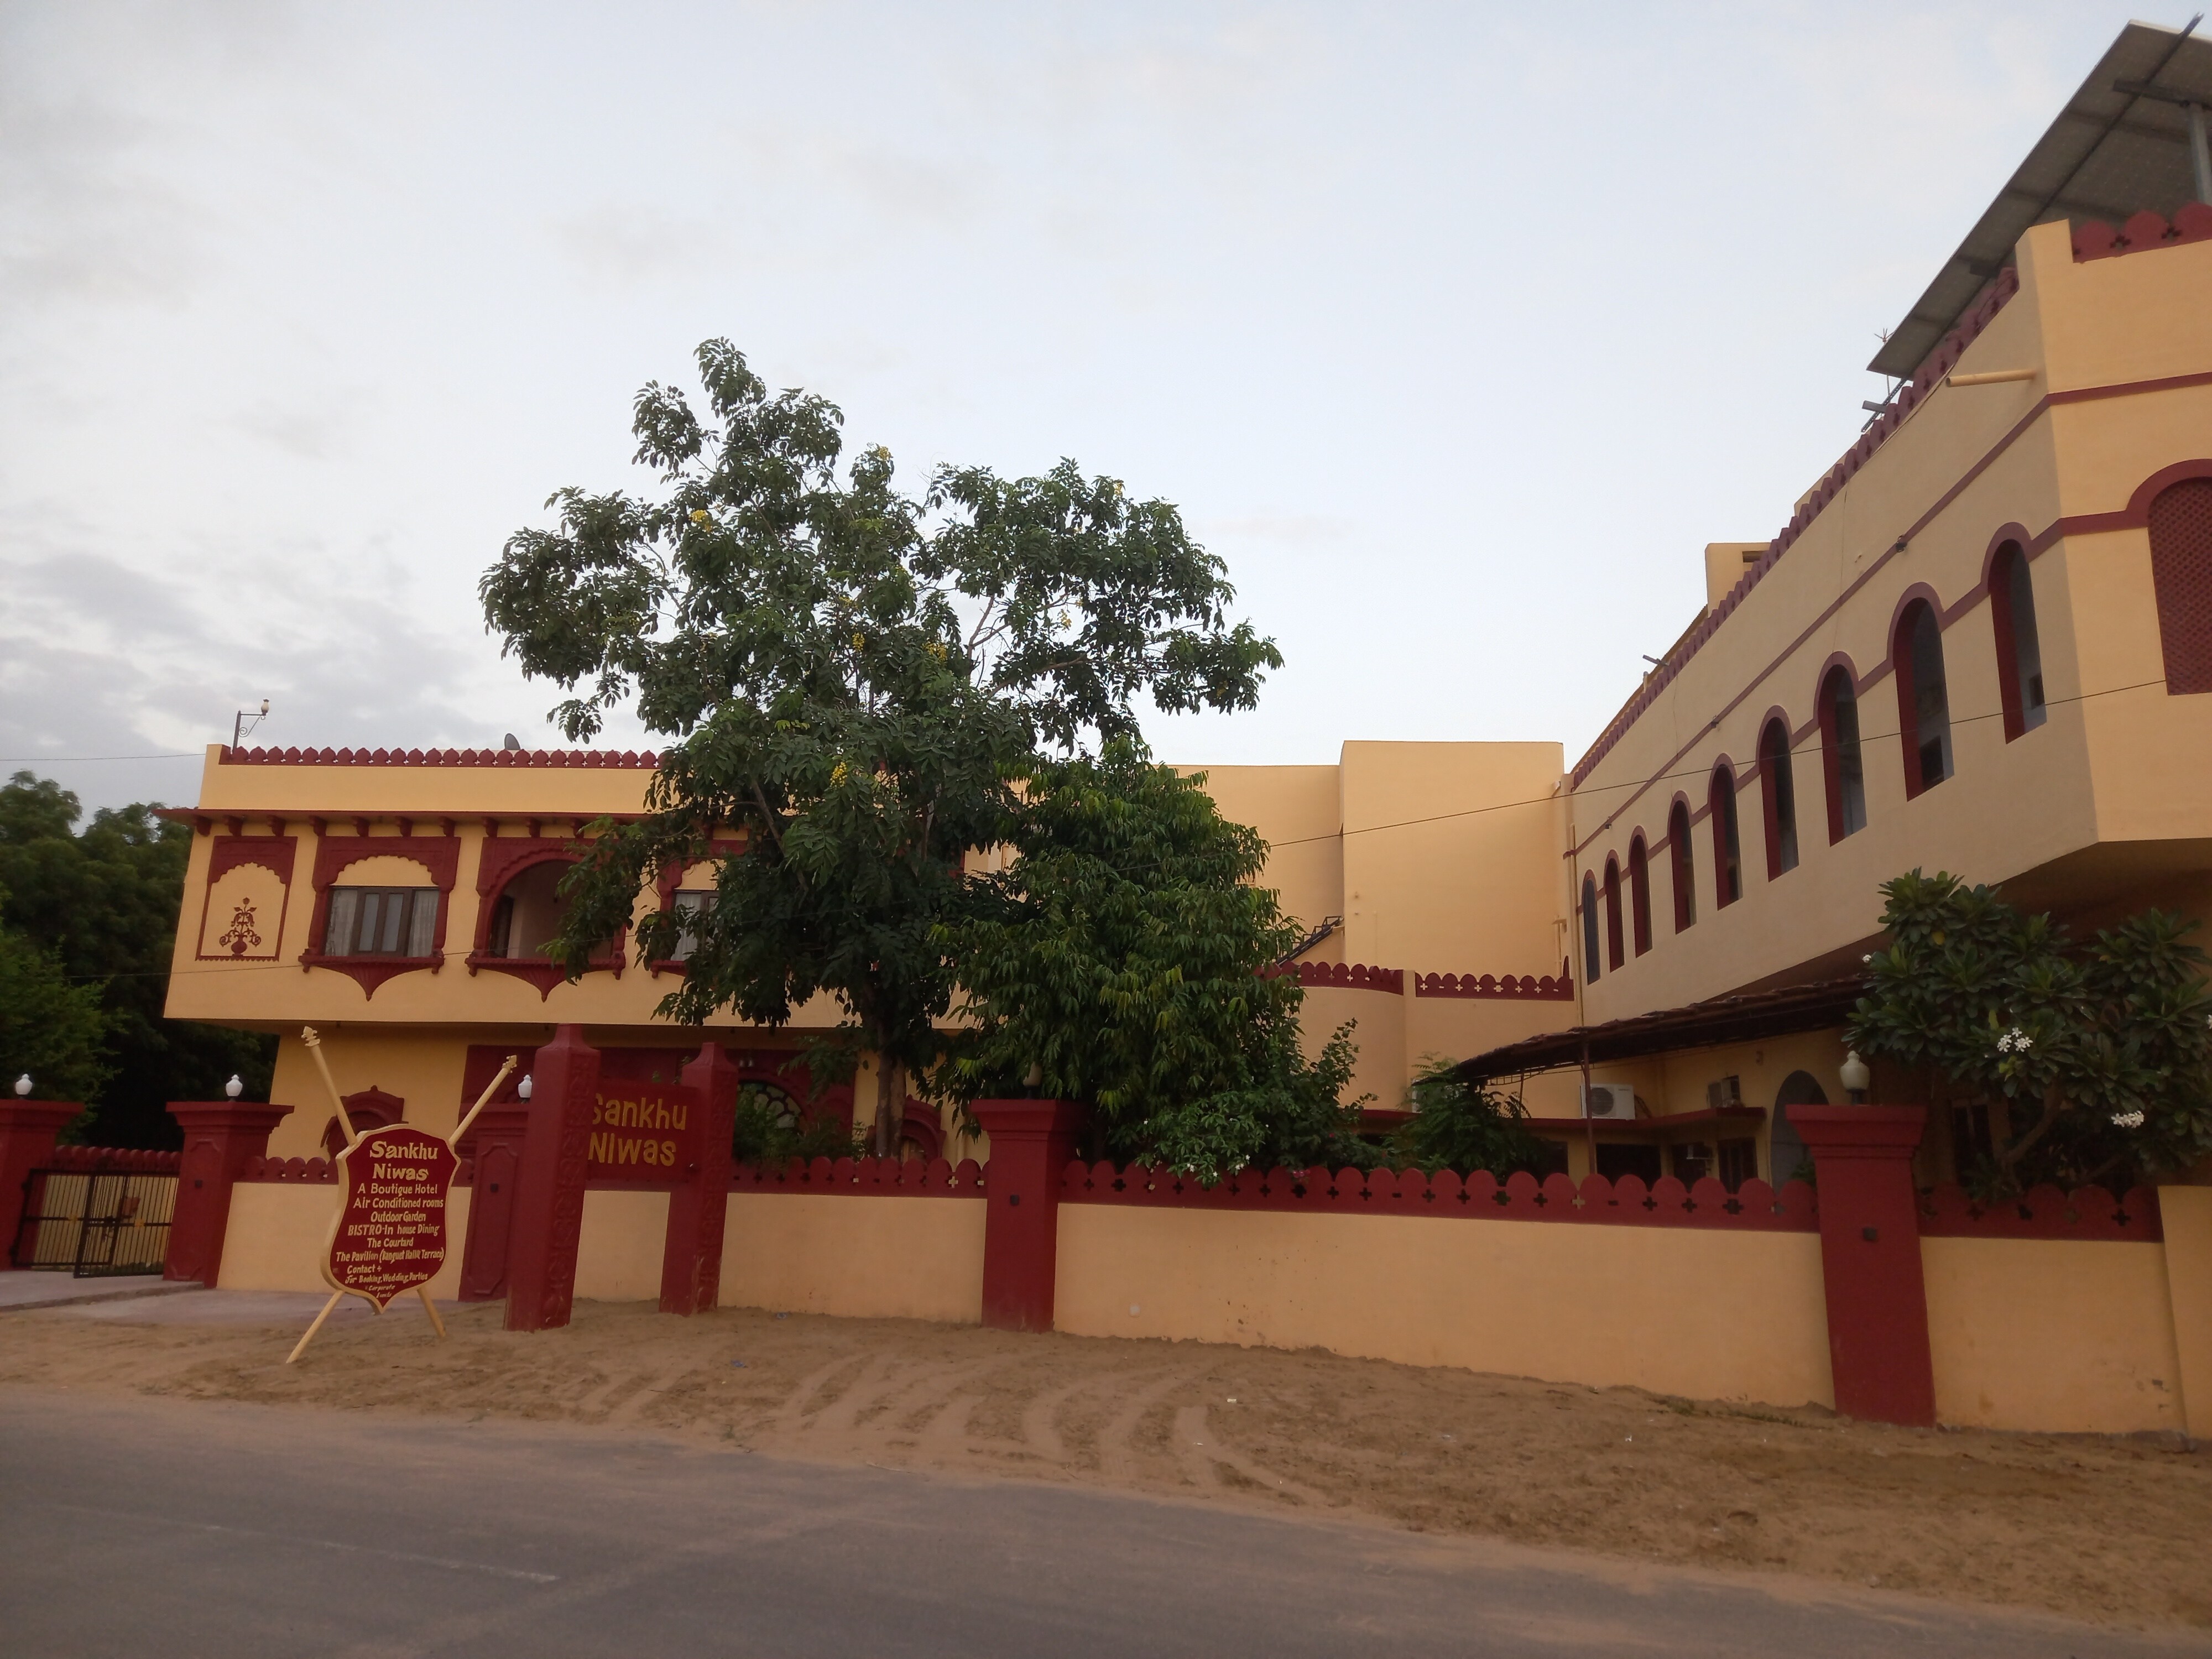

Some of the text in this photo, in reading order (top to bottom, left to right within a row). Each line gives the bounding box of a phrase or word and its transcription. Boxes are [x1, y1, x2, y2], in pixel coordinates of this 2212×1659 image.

[369, 1141, 438, 1160] Sankhu
[372, 1163, 429, 1181] Niwas
[357, 1183, 437, 1197] A Boutique Hotel
[353, 1197, 444, 1208] Air Conditioned rooms
[371, 1211, 426, 1222] Outdoor Garden
[397, 1224, 416, 1234] house
[418, 1224, 440, 1237] Dining
[367, 1238, 381, 1248] The
[336, 1251, 351, 1261] The
[347, 1265, 375, 1274] Contact
